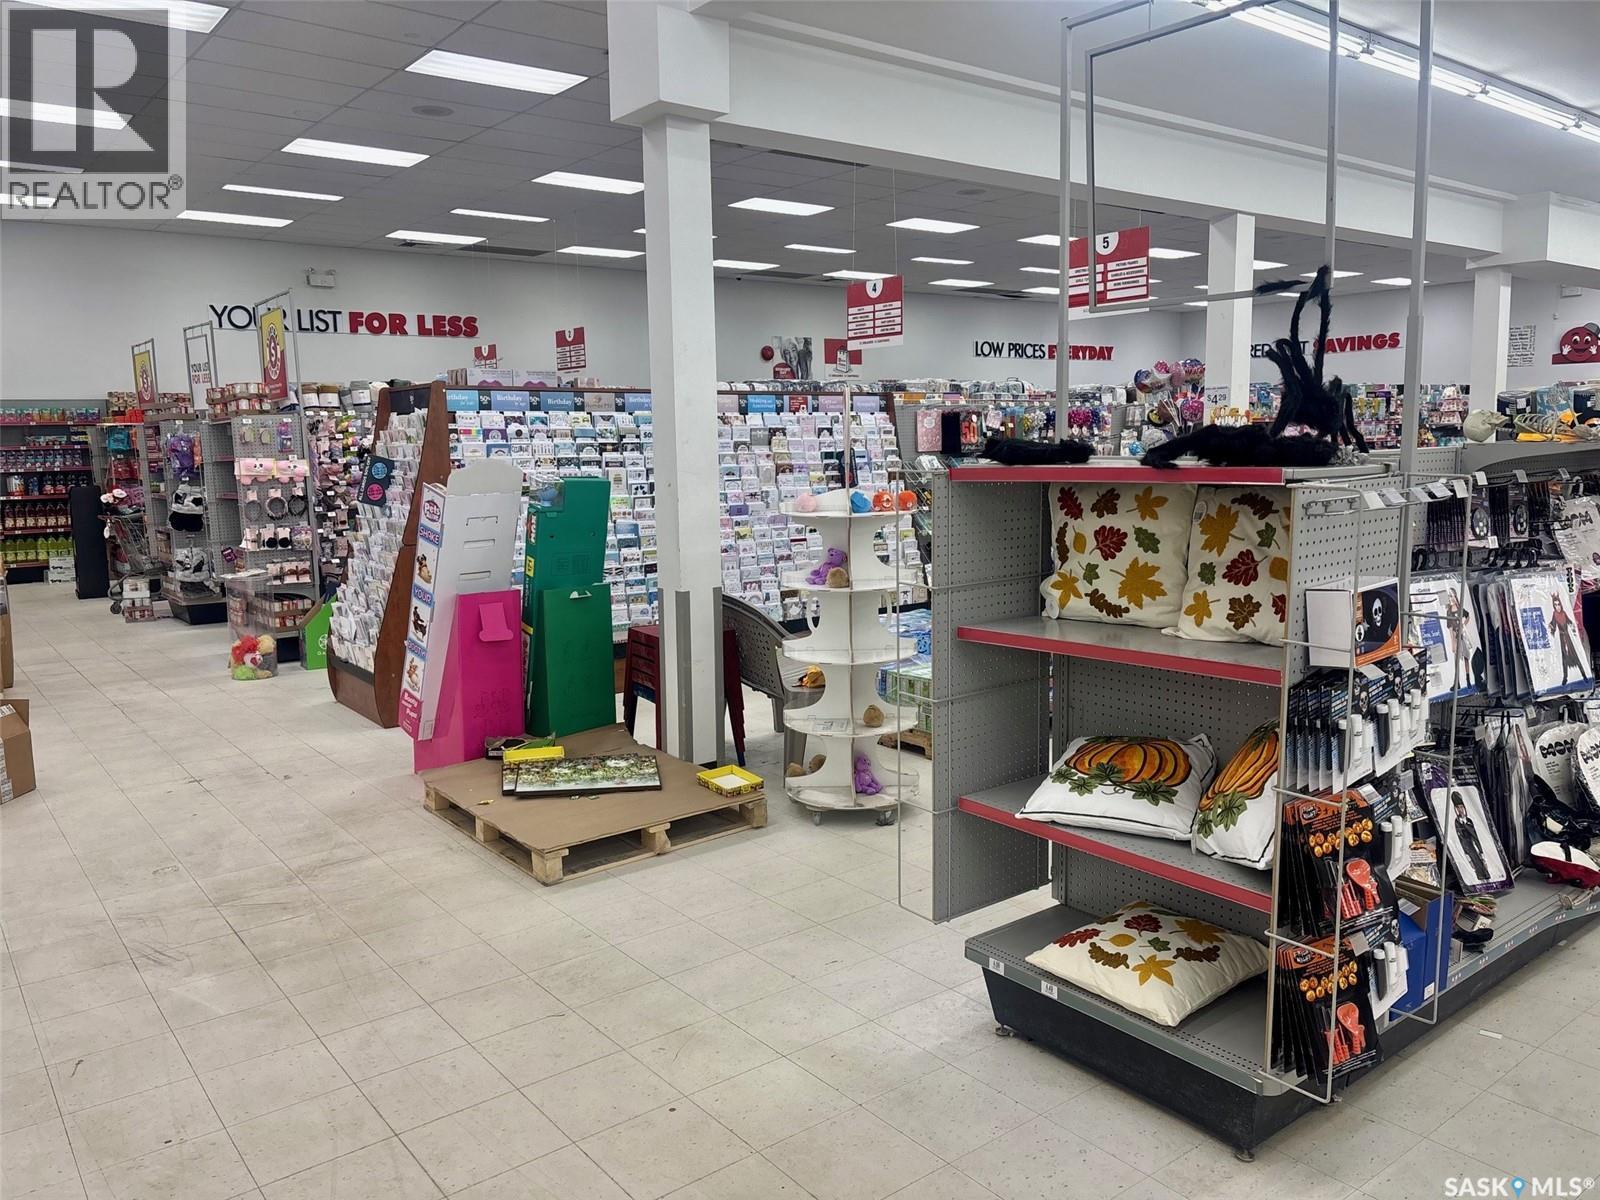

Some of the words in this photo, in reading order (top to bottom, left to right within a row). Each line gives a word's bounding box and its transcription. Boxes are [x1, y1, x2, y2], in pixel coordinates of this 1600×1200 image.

[1102, 236, 1110, 249] 5
[871, 282, 877, 293] 4
[297, 309, 342, 332] LIST
[349, 311, 409, 336] FOR
[417, 314, 479, 338] LESS
[975, 340, 1005, 357] LOW
[1008, 342, 1046, 359] PRICES
[1048, 344, 1115, 361] EERYDAY
[547, 398, 572, 406] Birthday
[424, 502, 440, 516] Pets
[419, 526, 440, 546] SHAKE
[414, 587, 432, 603] YOUR
